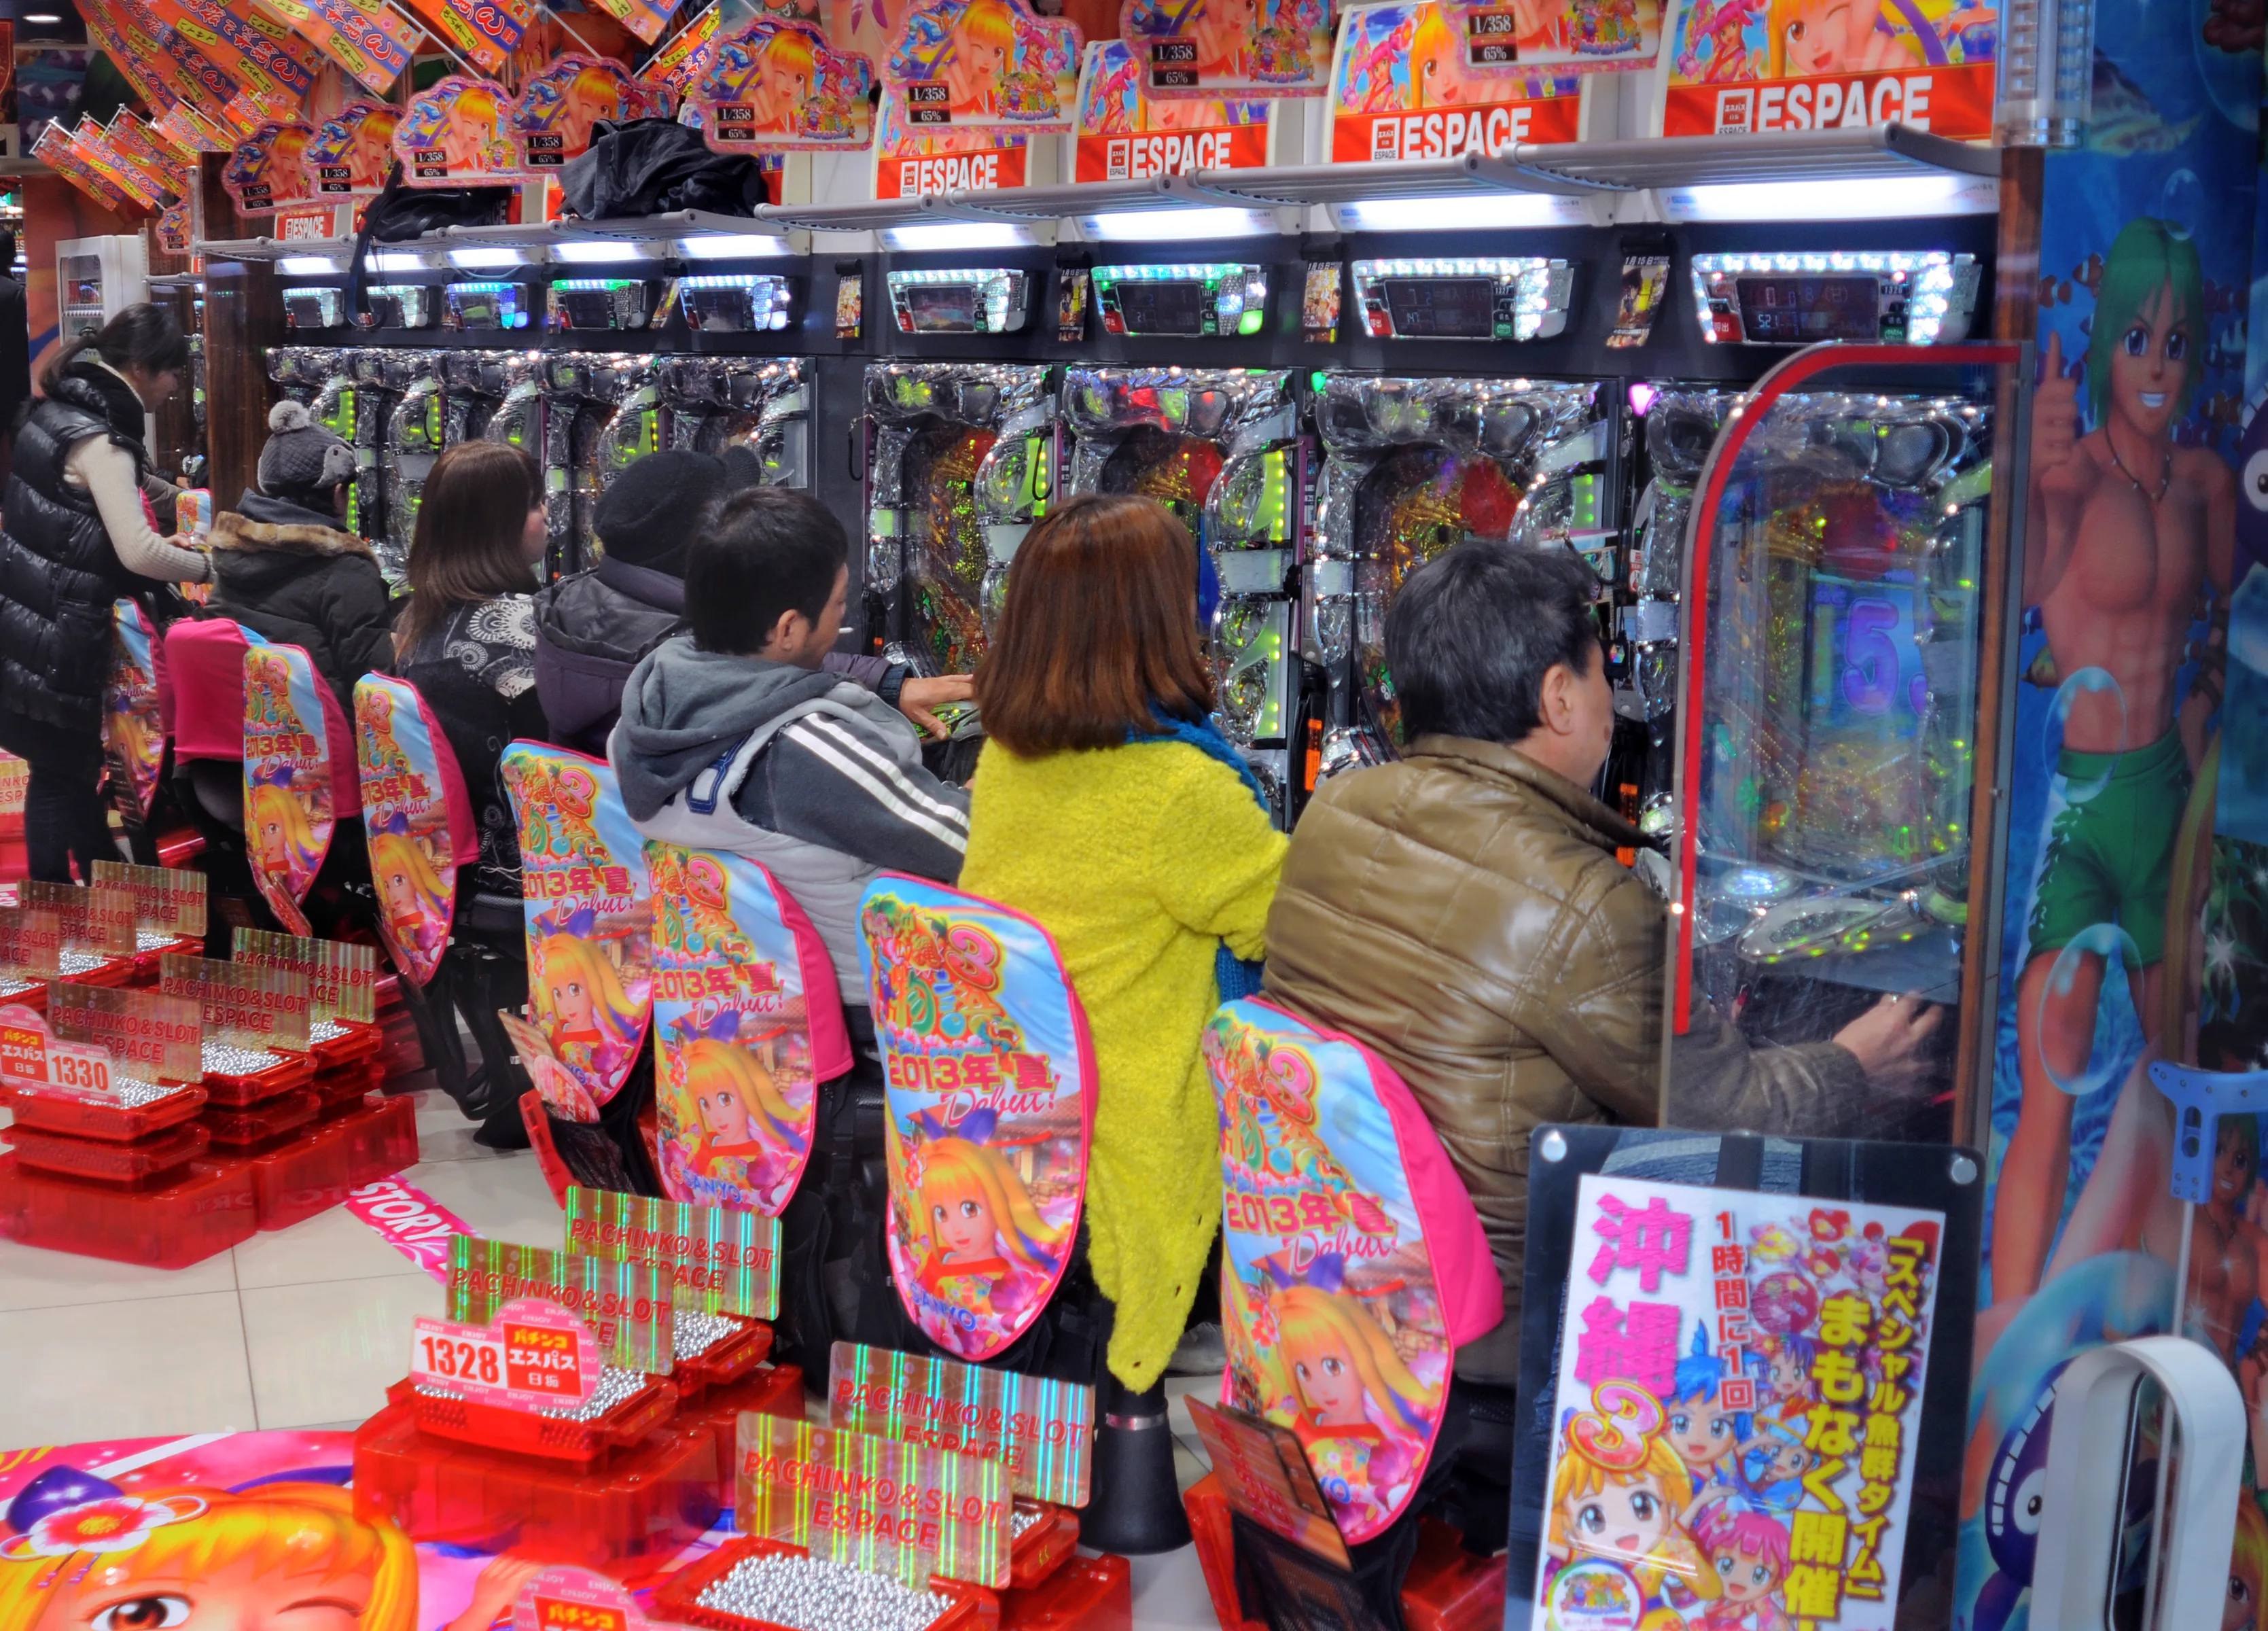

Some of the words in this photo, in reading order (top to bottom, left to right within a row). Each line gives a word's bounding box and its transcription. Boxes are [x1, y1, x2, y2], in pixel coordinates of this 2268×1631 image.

[1476, 14, 1512, 34] 1/358
[1157, 45, 1194, 61] 1/358
[1483, 45, 1507, 61] 65%
[1165, 72, 1188, 84] 65%
[914, 86, 946, 102] 1/358
[1765, 76, 1933, 133] ESPACE
[722, 107, 752, 121] 1/358
[921, 110, 942, 122] 65%
[531, 133, 560, 148] 1/358
[728, 128, 747, 140] 65%
[1404, 107, 1531, 159] ESPACE
[416, 150, 444, 164] 1/358
[537, 154, 557, 164] 65%
[1133, 133, 1232, 178] ESPACE
[1373, 150, 1396, 161] ESPACE
[423, 167, 442, 177] 65%
[921, 154, 999, 194] ESPACE
[1109, 167, 1127, 176] ESPACE
[294, 216, 324, 239] ESPACE
[601, 866, 635, 896] 夏
[135, 901, 179, 922] SPACE
[60, 921, 107, 943] SPACE
[162, 976, 249, 1006] PACHINKO
[264, 990, 309, 1014] SLOT
[652, 964, 739, 1002] 2013年
[742, 961, 780, 997] 夏
[52, 1004, 137, 1035] PACHINKO
[154, 1019, 200, 1044] SLOT
[202, 1004, 275, 1032] ESPACE
[4, 1029, 39, 1046] パチンコ
[1, 1044, 45, 1062] エスパス
[51, 1055, 109, 1091] 1330
[889, 1053, 1004, 1093] 2013年
[1010, 1051, 1057, 1092] 夏
[939, 1074, 1061, 1128] Debut!
[350, 1181, 461, 1242] STORY
[1224, 1192, 1344, 1236] 2013年
[571, 1218, 689, 1257] PACHINKO
[712, 1240, 775, 1271] SLOT
[451, 1267, 580, 1309] PACHINKO
[601, 1293, 670, 1325] SLOT
[1711, 1210, 1756, 1413] 1時間に1回
[514, 1329, 568, 1349] パチンコ
[420, 1336, 499, 1384] 1328
[509, 1349, 576, 1371] エスパス
[836, 1378, 983, 1428] PACHINKO
[1010, 1411, 1091, 1450] SLOT
[1845, 1235, 1926, 1602] 「スペシャル魚群タイム」
[1783, 1294, 1873, 1631] まもなく開催
[743, 1451, 896, 1504] PACHINKO
[924, 1487, 1008, 1530] SLOT
[813, 1498, 942, 1552] ESPACE
[548, 1602, 614, 1629] パチンコ
